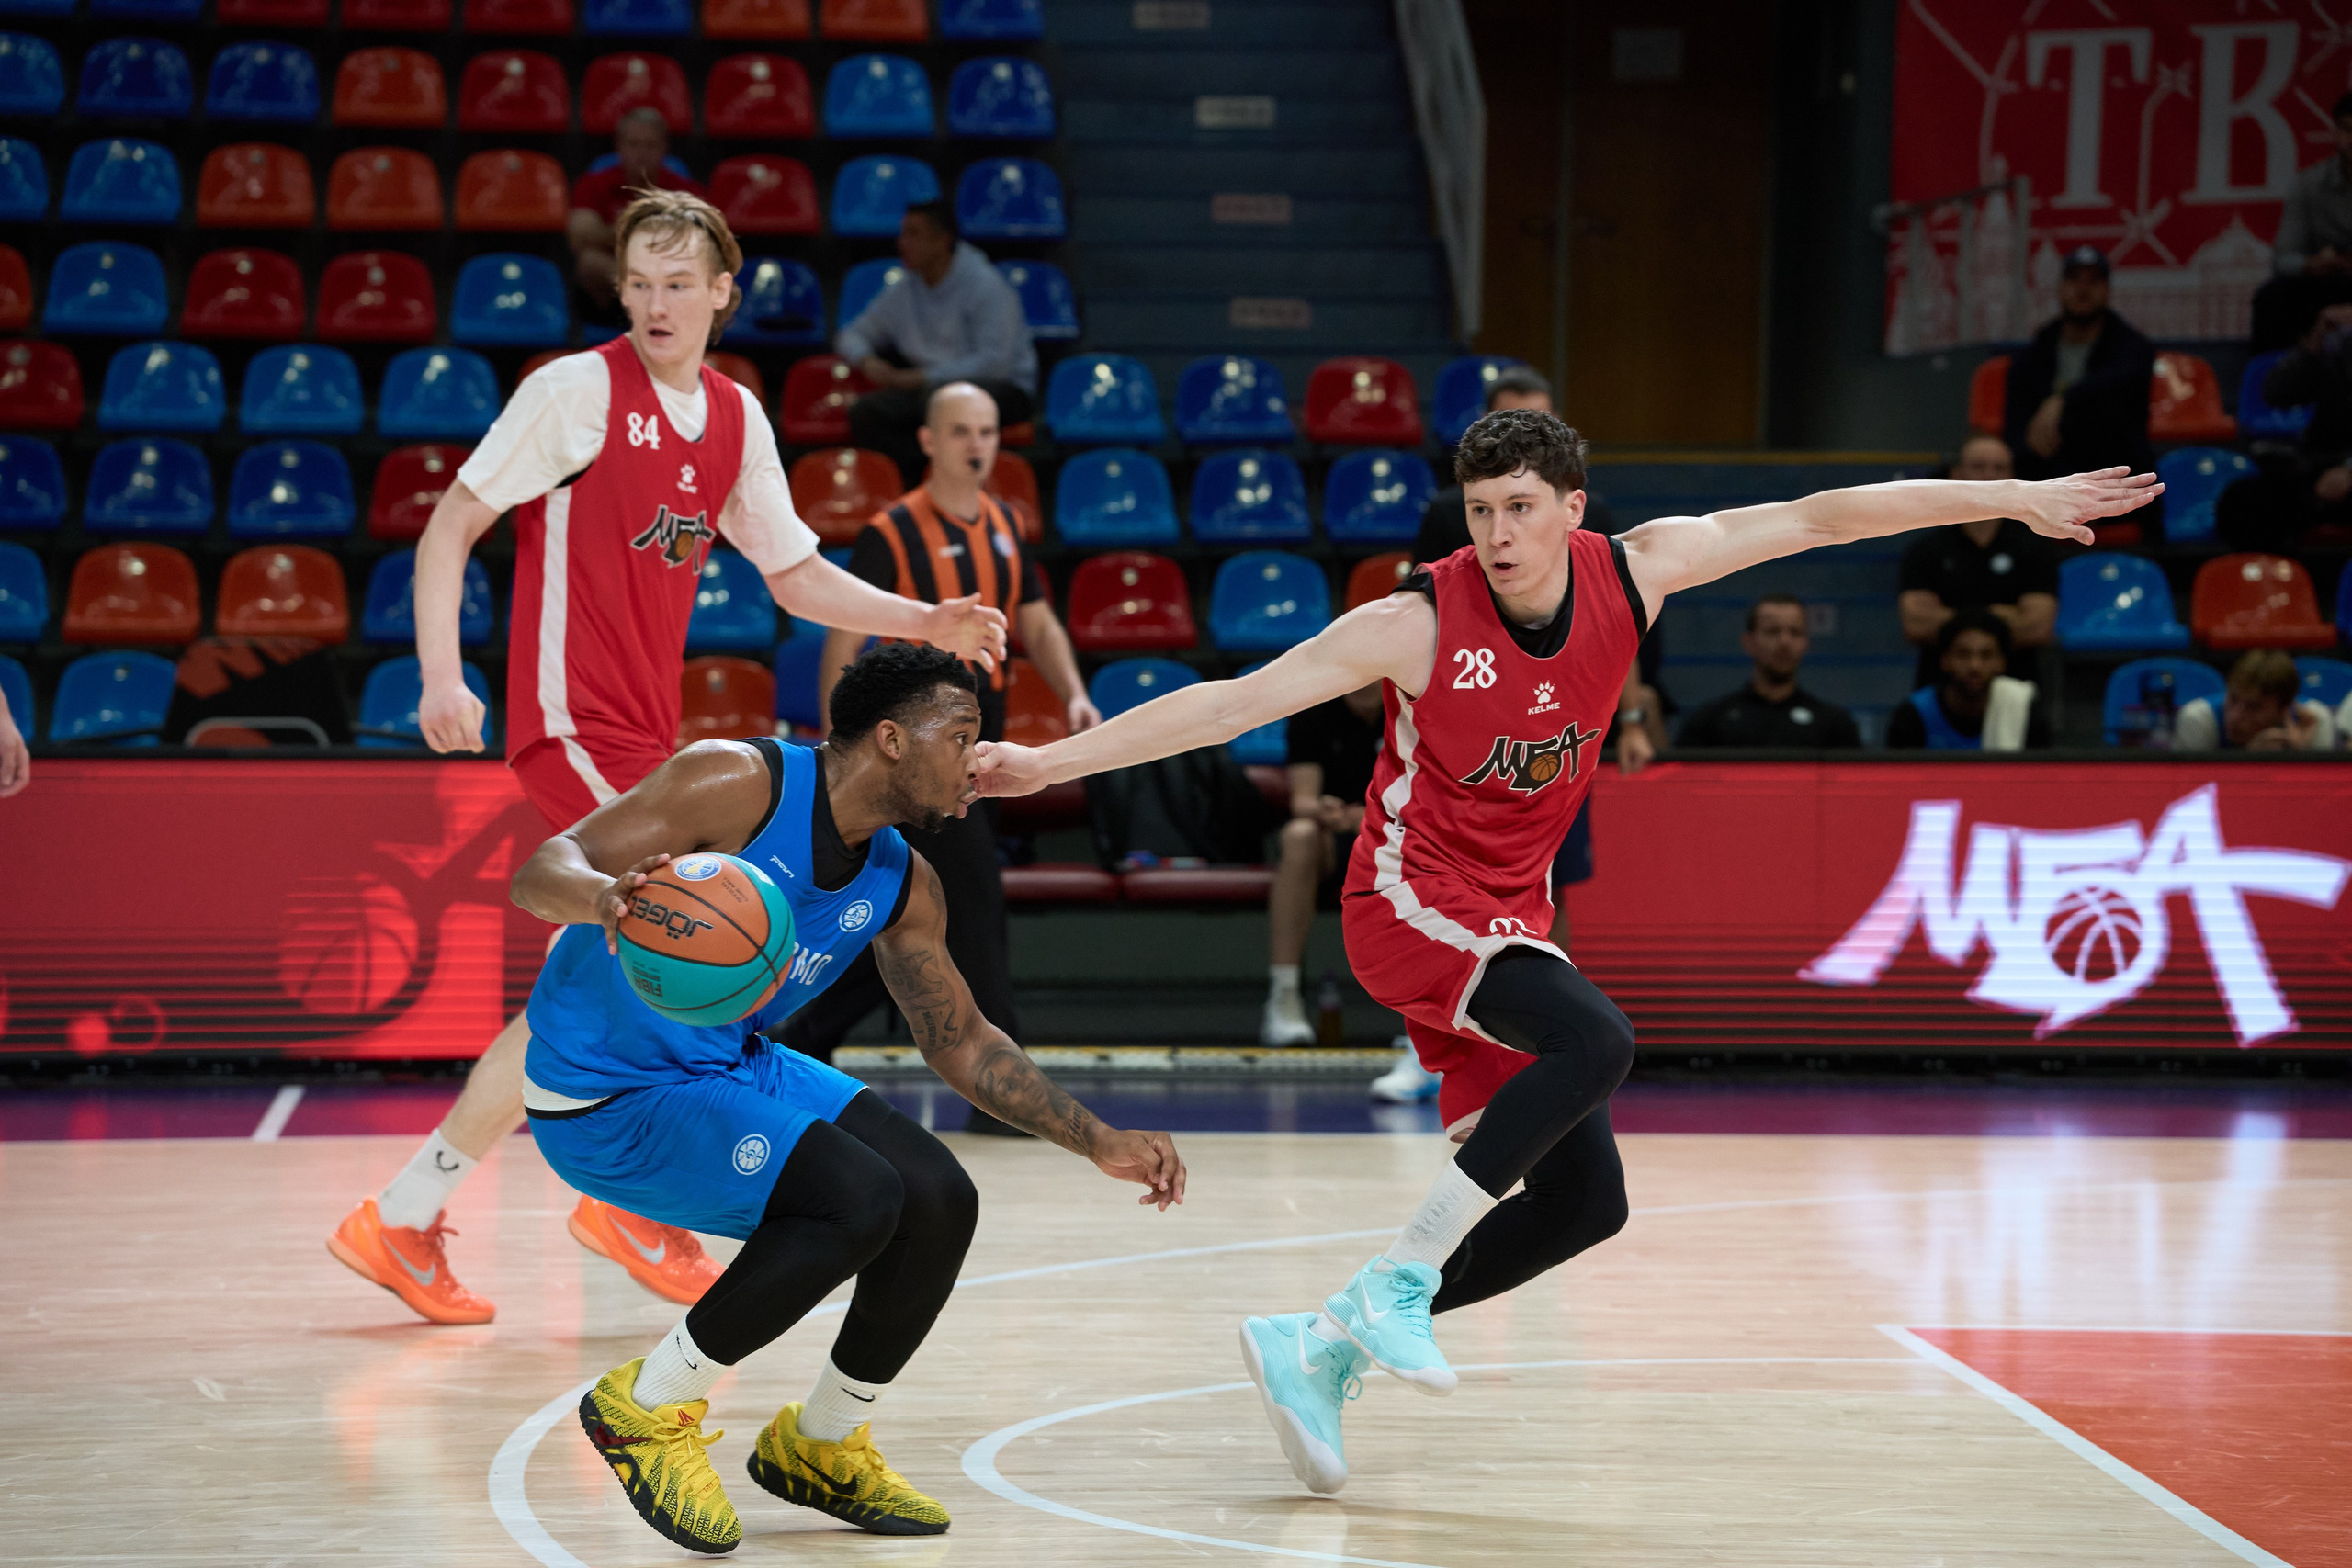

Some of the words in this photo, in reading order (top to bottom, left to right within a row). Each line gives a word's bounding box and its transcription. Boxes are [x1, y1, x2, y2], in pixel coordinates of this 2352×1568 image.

[627, 412, 661, 450] 84
[1453, 648, 1498, 690] 28
[1527, 702, 1561, 716] KELME
[634, 975, 662, 998] FIBA
